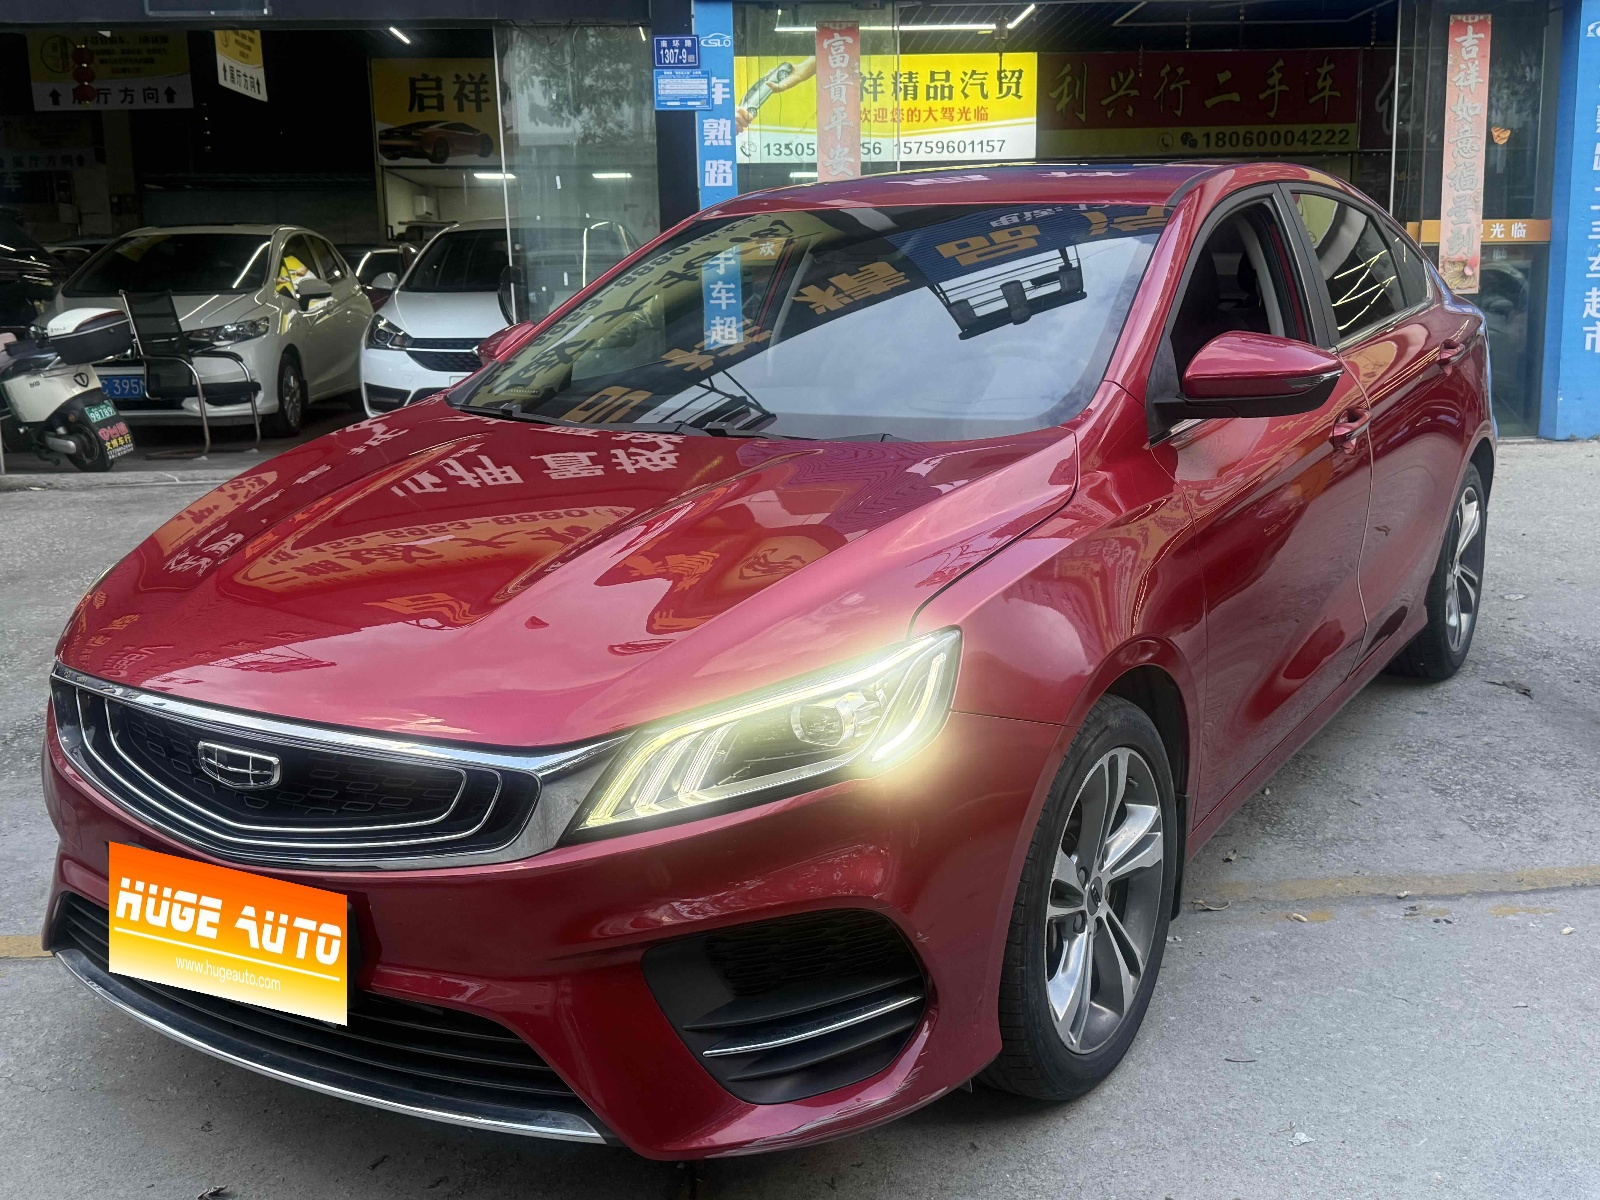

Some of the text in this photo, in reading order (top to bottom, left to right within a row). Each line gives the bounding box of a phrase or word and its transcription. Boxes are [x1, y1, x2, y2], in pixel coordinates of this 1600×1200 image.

[660, 39, 693, 48] 南环路
[659, 48, 688, 64] 1307-9
[73, 87, 160, 105] 厅方向
[408, 72, 492, 114] 启祥
[1049, 55, 1342, 122] 利兴行二手车
[894, 139, 1007, 155] 15759601157
[1202, 127, 1351, 151] 18060004222
